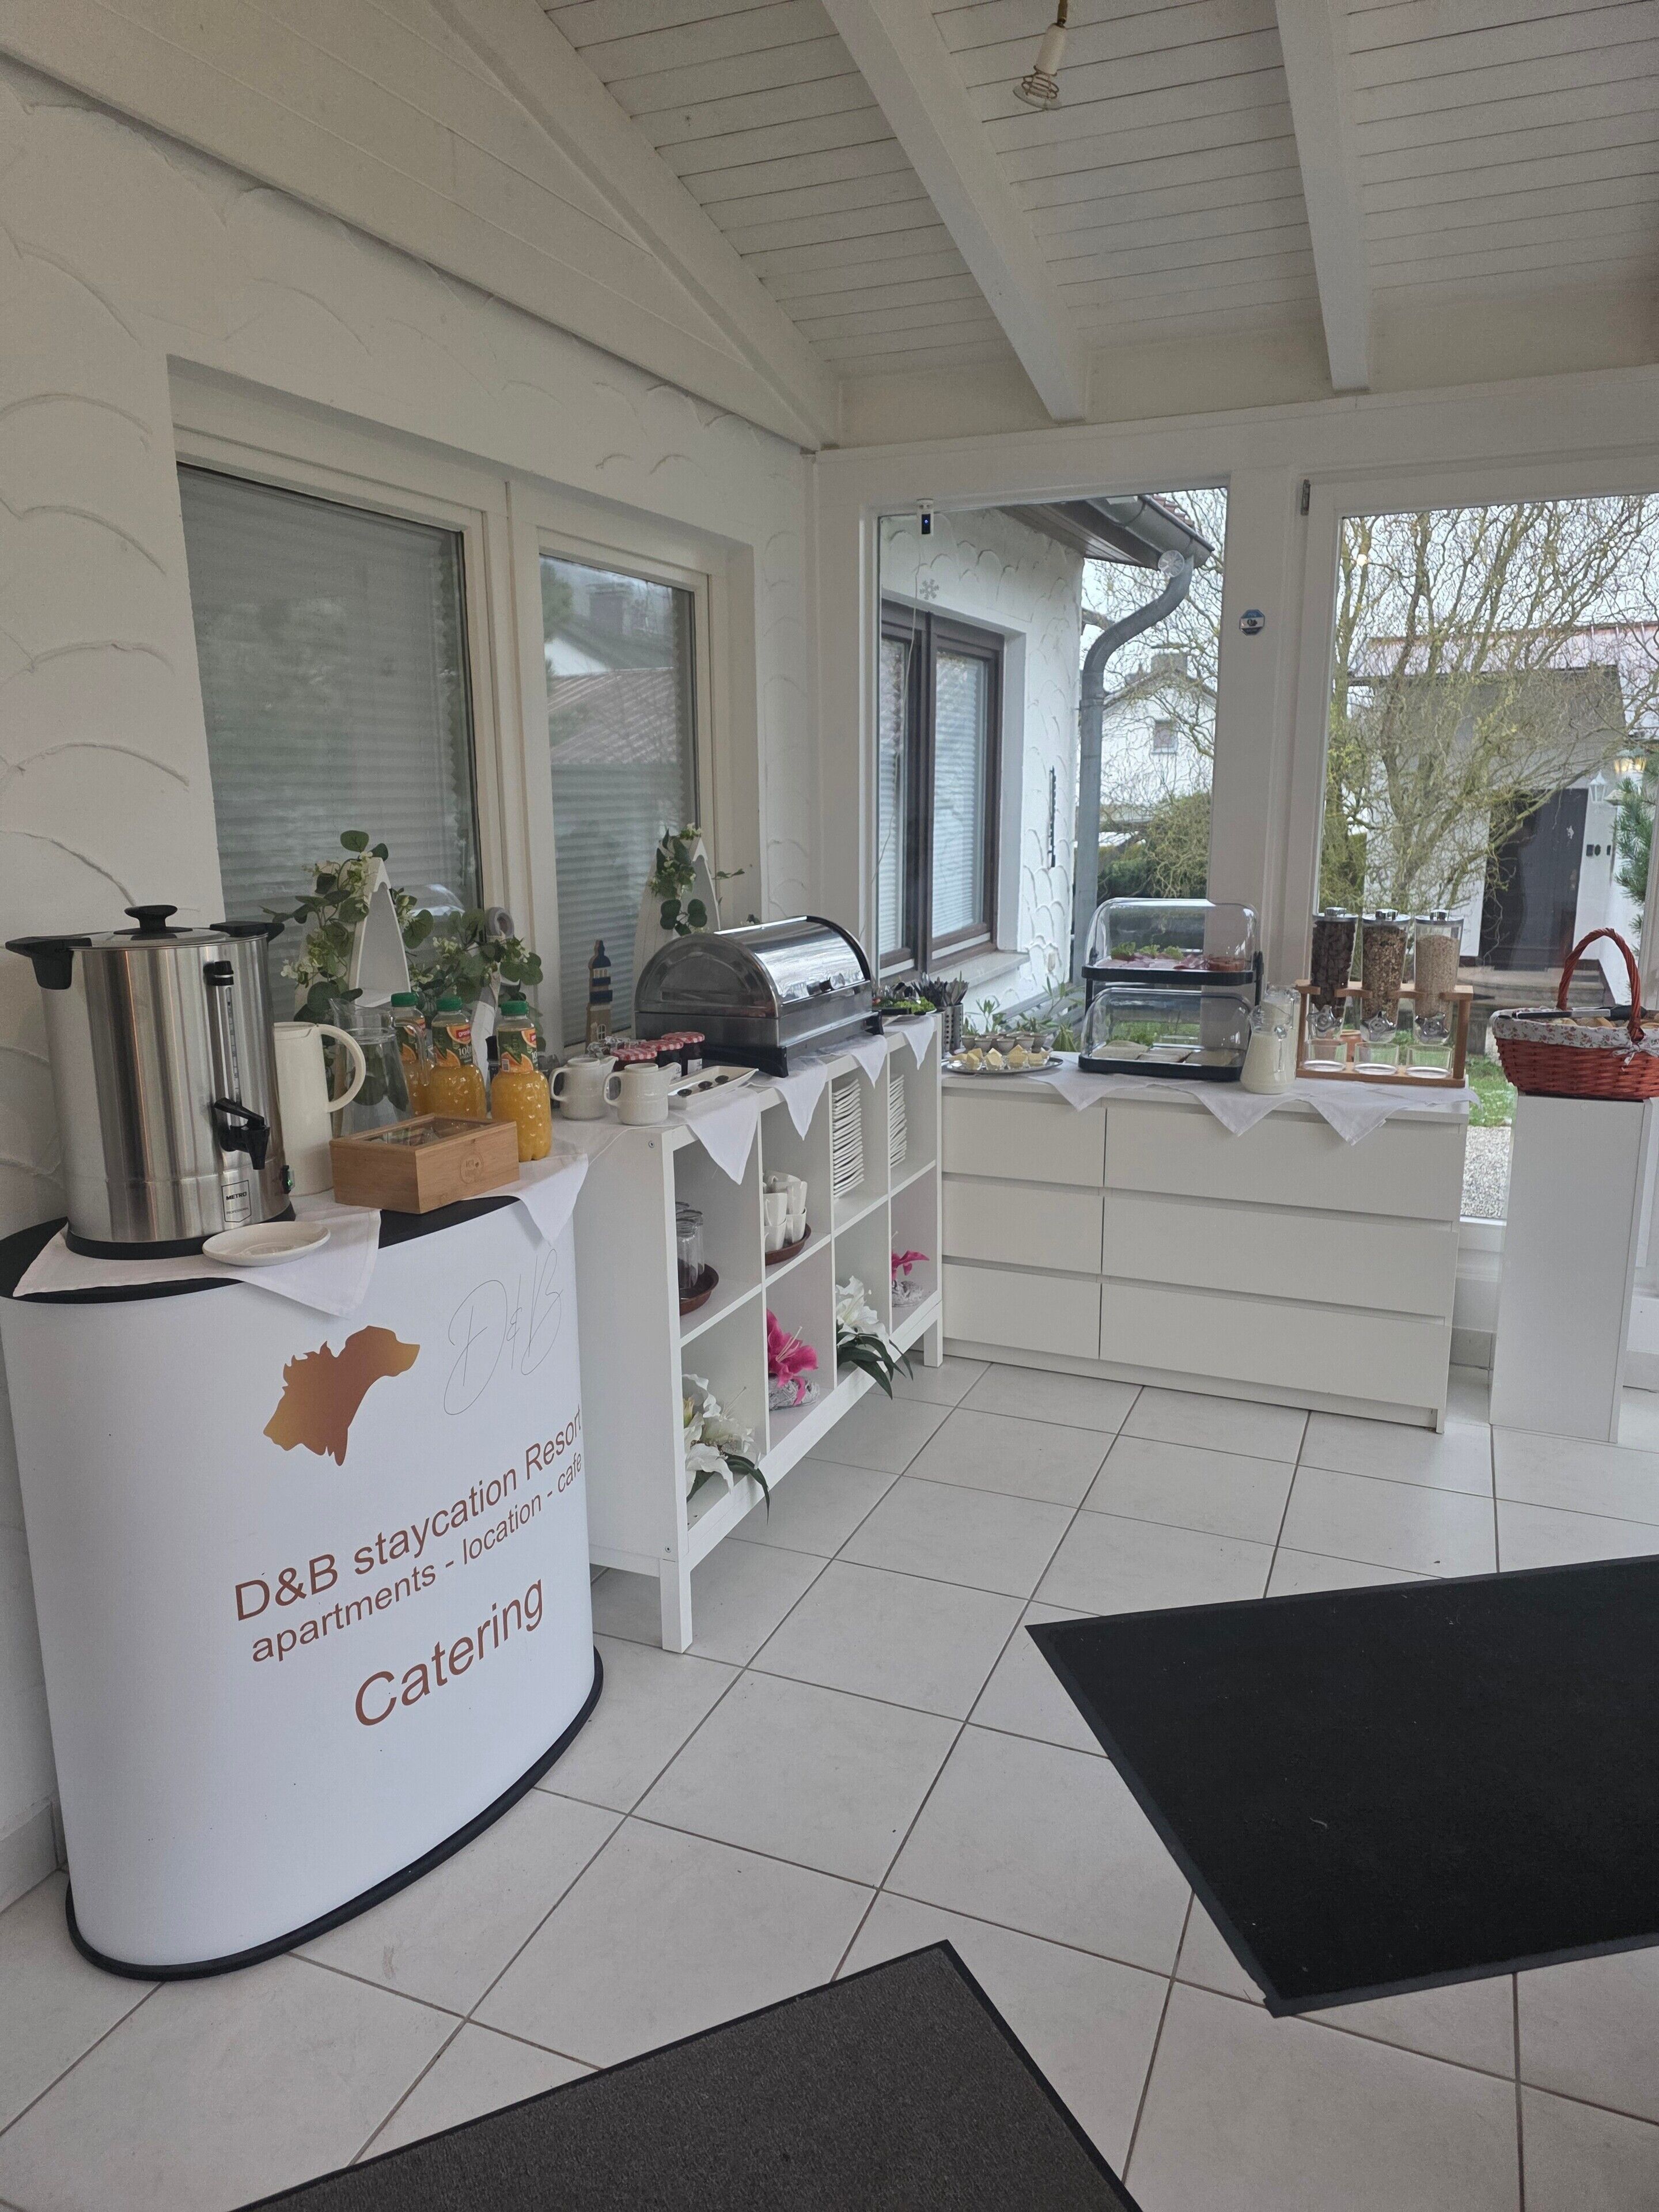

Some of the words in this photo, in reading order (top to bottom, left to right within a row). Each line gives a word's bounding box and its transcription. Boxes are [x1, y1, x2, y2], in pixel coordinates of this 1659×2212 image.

[226, 1191, 247, 1200] METRO
[235, 1554, 339, 1622] D&B
[354, 1467, 517, 1575] staycation
[525, 1404, 581, 1480] Resort
[252, 1562, 436, 1664] apartments
[463, 1496, 541, 1565] location
[558, 1452, 582, 1493] cafe
[354, 1579, 543, 1726] Catering
